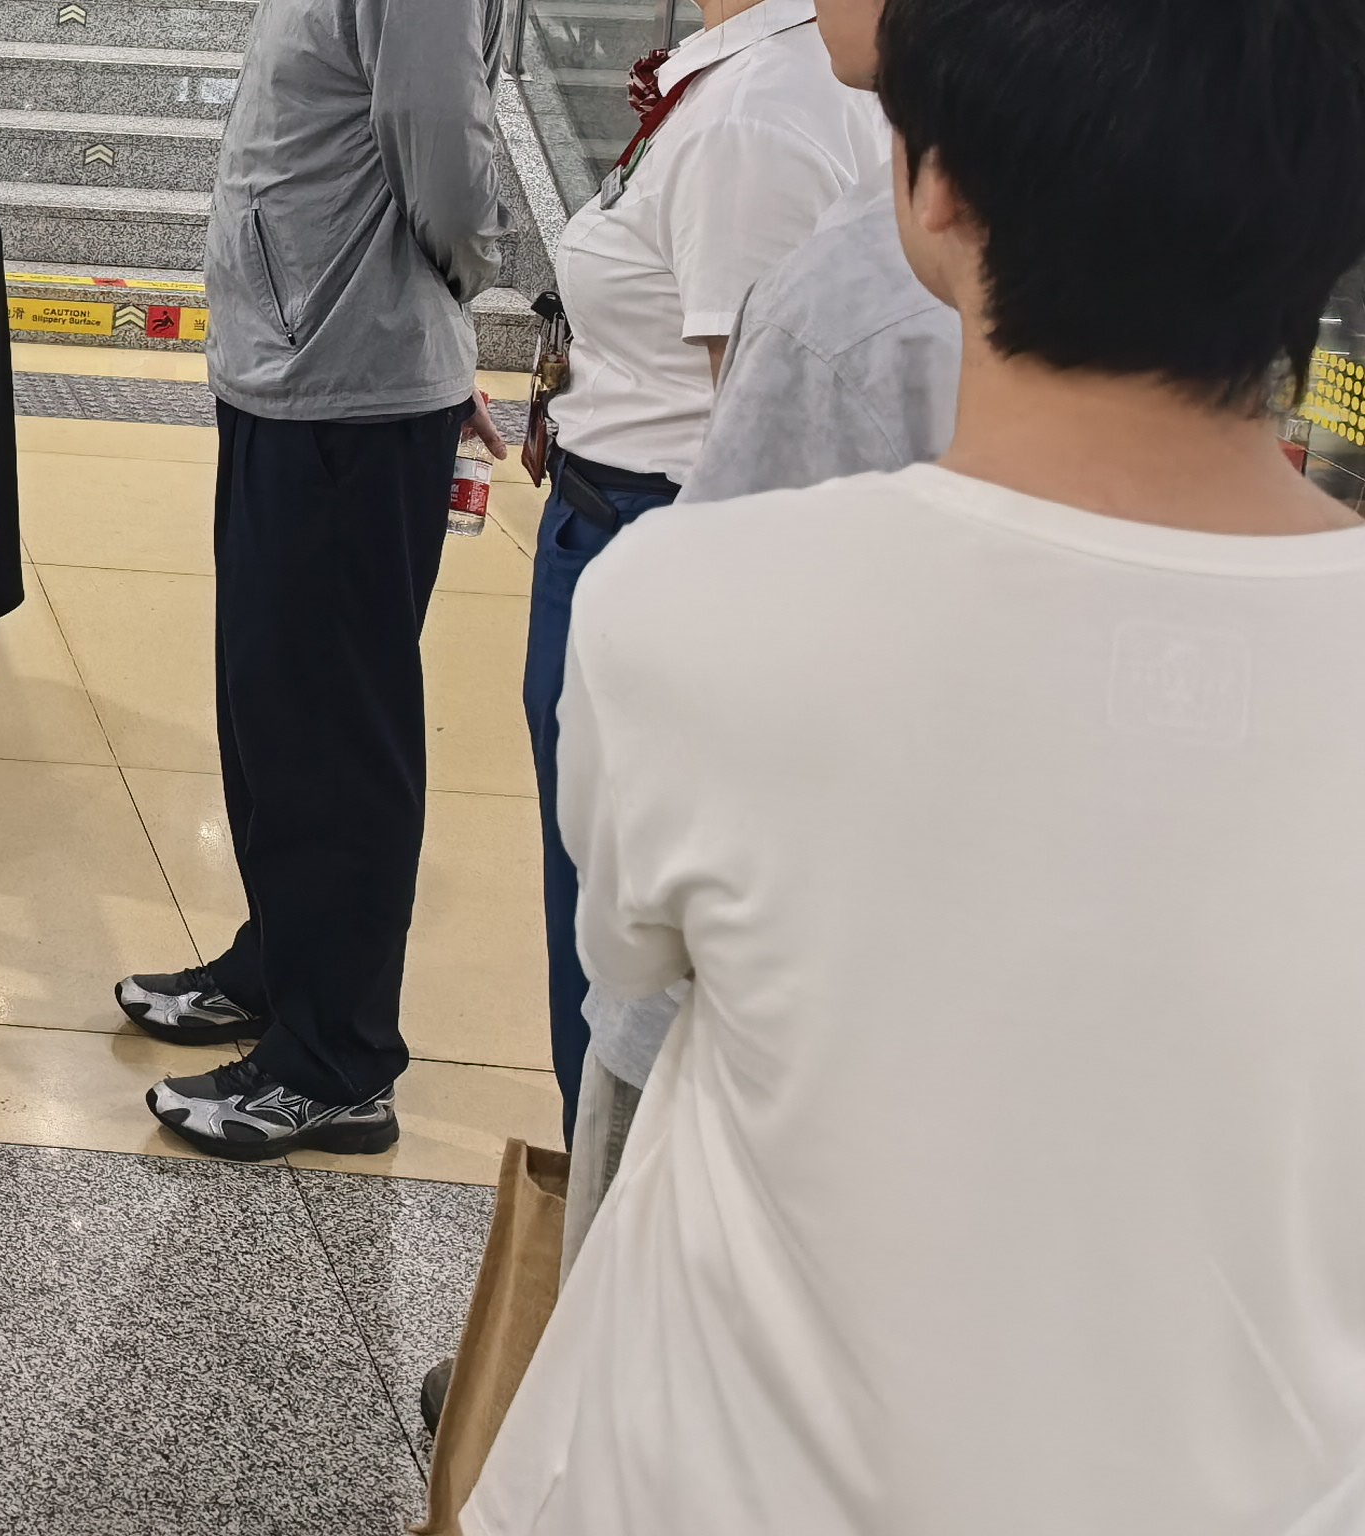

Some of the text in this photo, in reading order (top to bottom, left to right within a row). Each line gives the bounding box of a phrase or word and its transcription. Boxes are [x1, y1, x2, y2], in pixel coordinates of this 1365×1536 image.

[43, 308, 91, 318] CAUTION!
[32, 315, 101, 326] Slippery Surface
